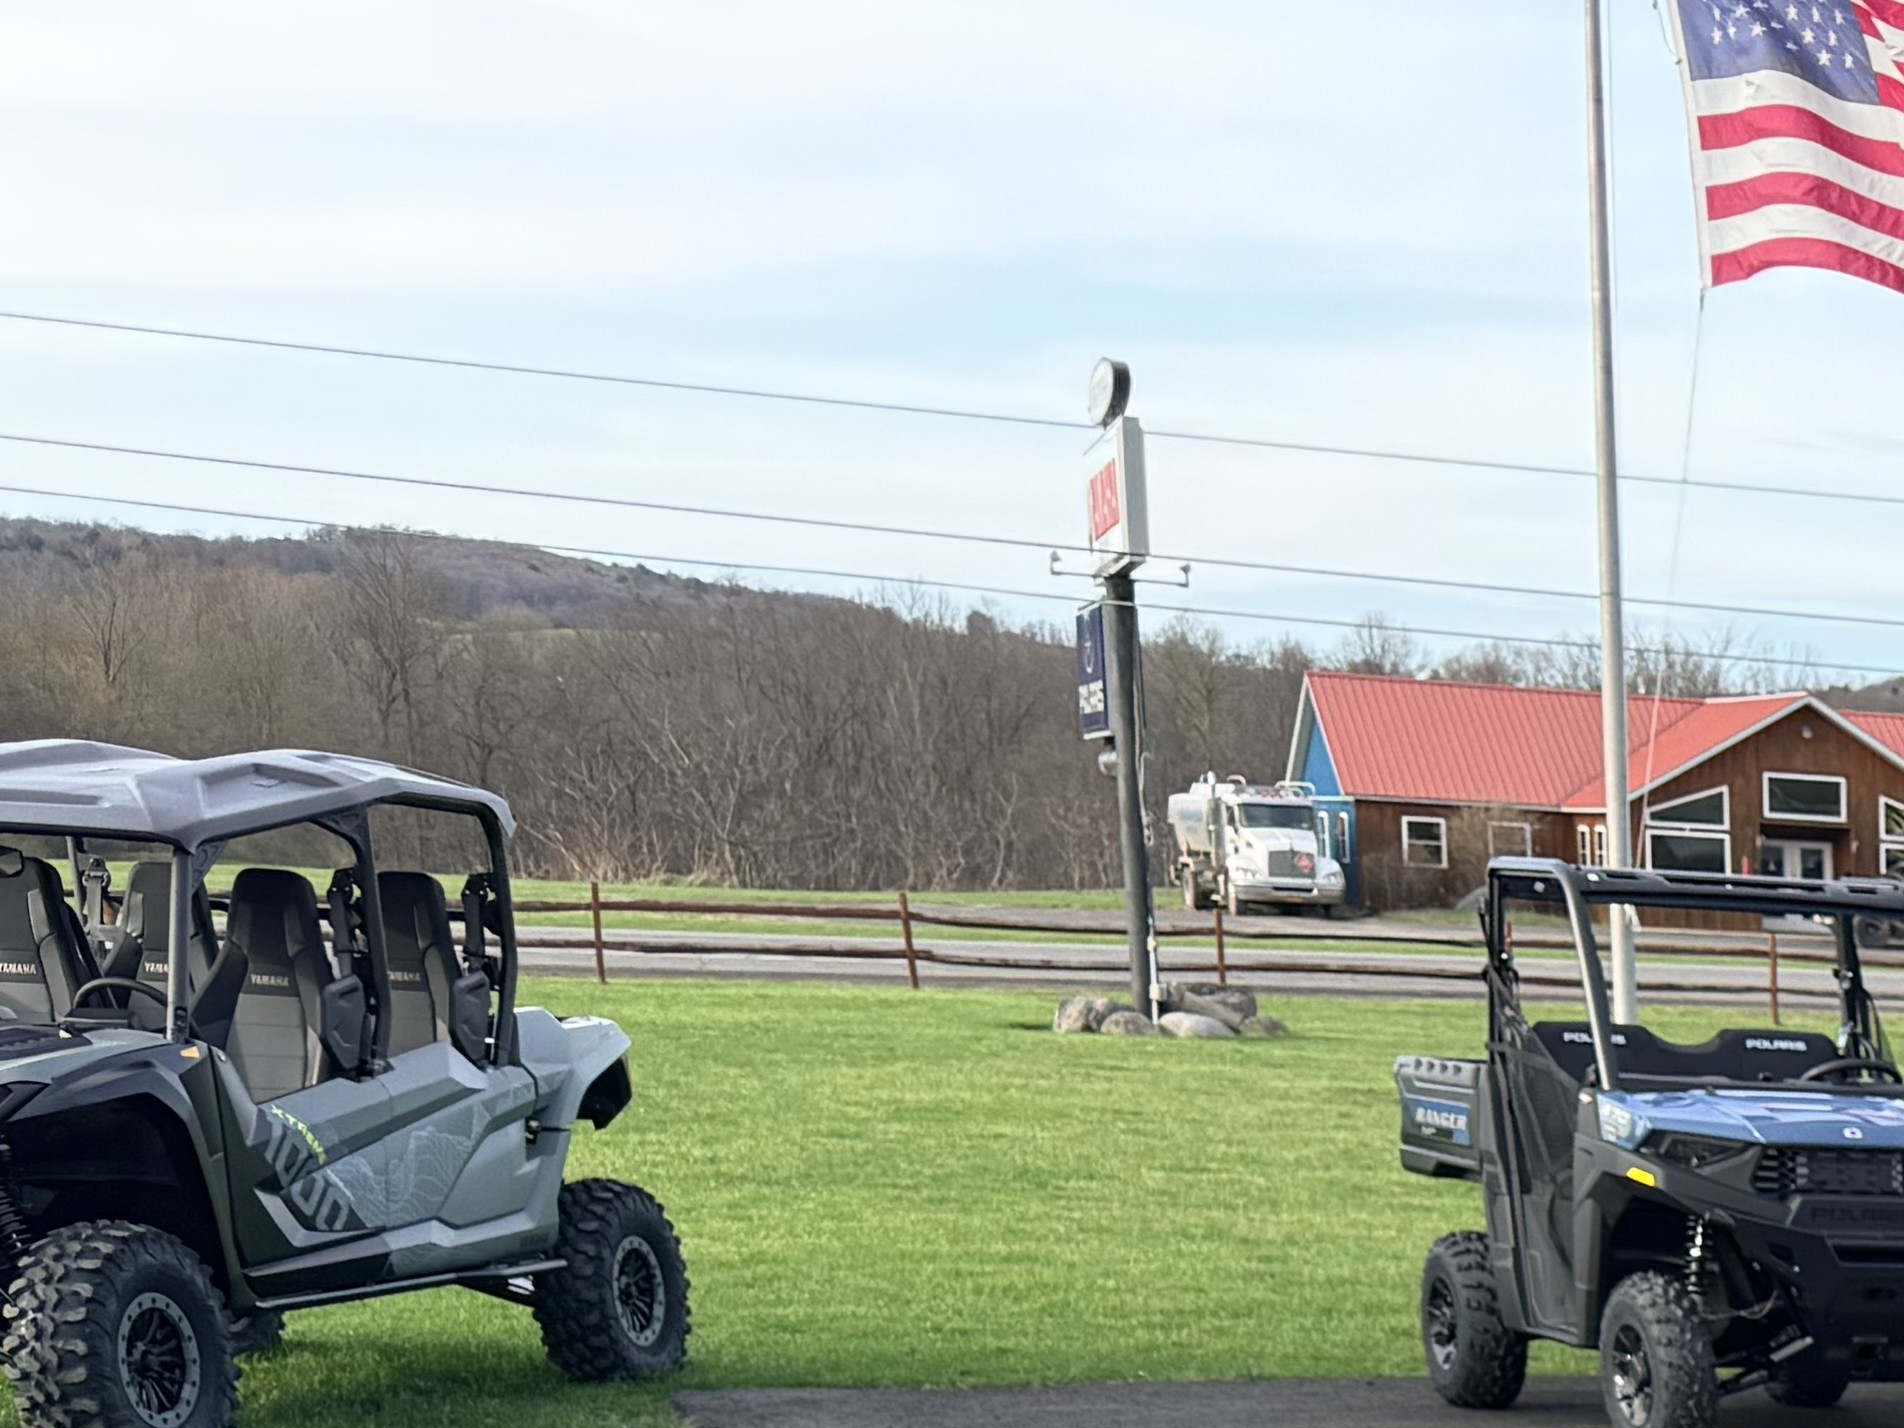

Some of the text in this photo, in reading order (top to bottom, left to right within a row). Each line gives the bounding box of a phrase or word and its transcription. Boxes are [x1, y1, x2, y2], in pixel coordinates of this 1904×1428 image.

[250, 974, 289, 988] YAMAHA
[1745, 1038, 1807, 1052] POLARIS
[1416, 1106, 1468, 1130] RANGER
